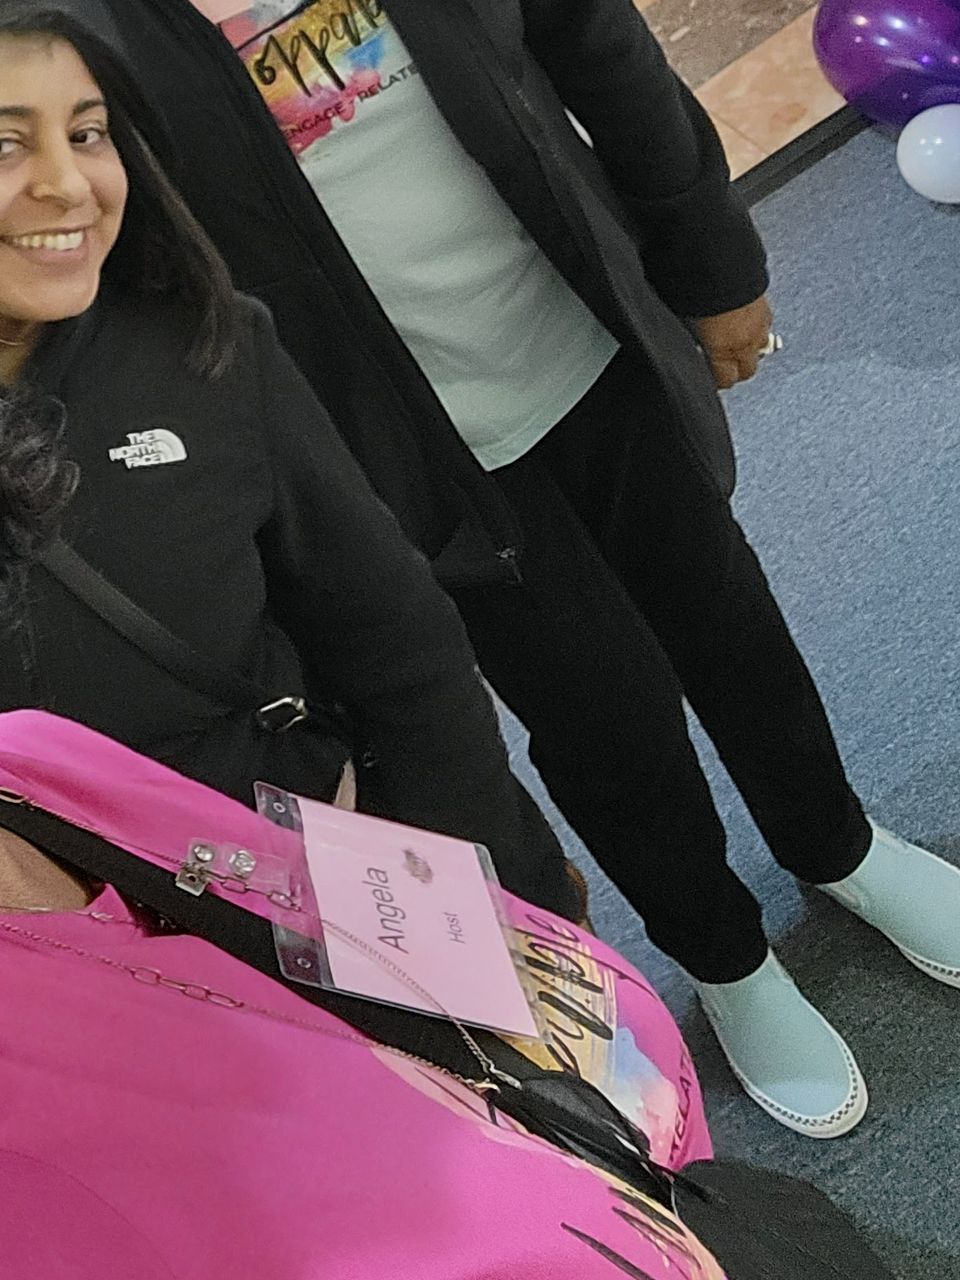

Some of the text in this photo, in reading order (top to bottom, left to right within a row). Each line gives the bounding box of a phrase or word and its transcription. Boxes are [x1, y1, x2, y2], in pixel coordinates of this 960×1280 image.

[126, 431, 155, 445] THE
[125, 454, 161, 470] FACE
[362, 867, 409, 955] Angela
[443, 911, 466, 945] Host
